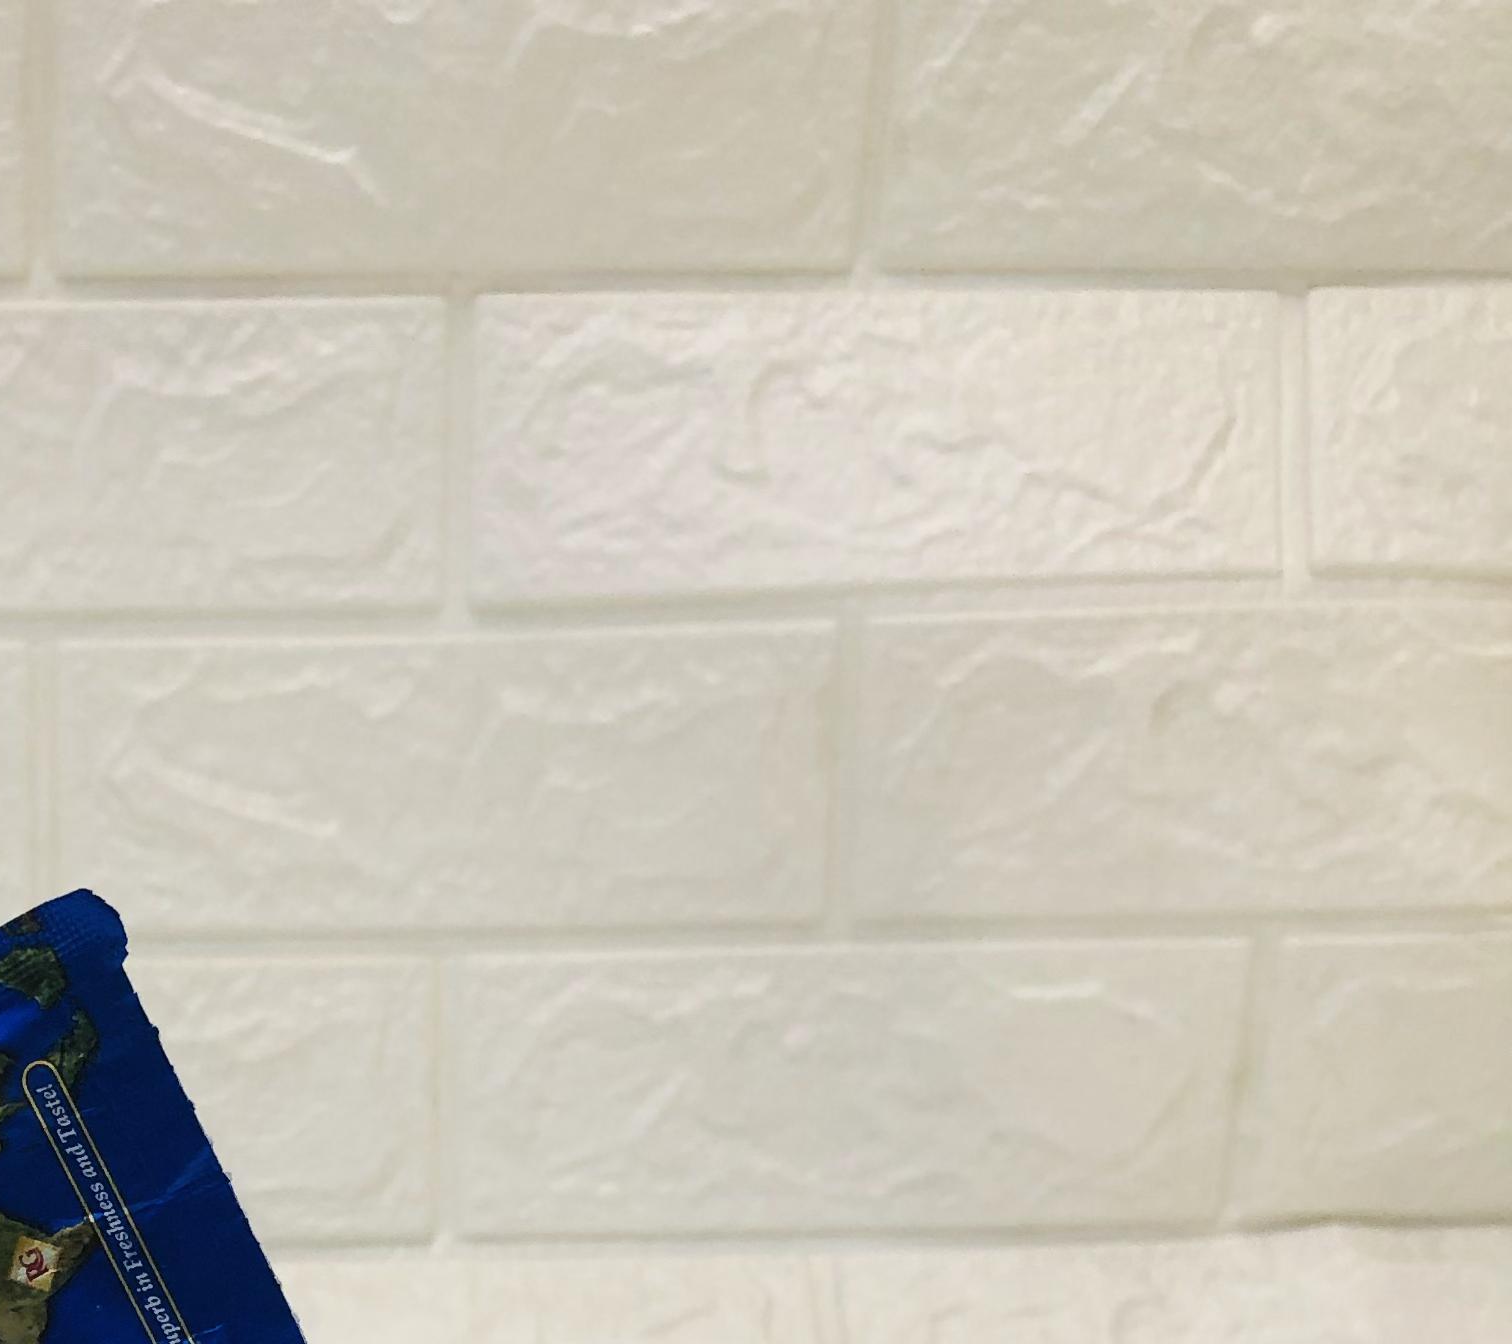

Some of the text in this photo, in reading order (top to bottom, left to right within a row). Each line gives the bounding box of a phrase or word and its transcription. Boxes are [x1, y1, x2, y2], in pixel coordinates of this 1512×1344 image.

[36, 1083, 76, 1144] Taste!
[65, 1143, 98, 1179] and
[90, 1181, 143, 1273] Freshness
[134, 1271, 154, 1293] in
